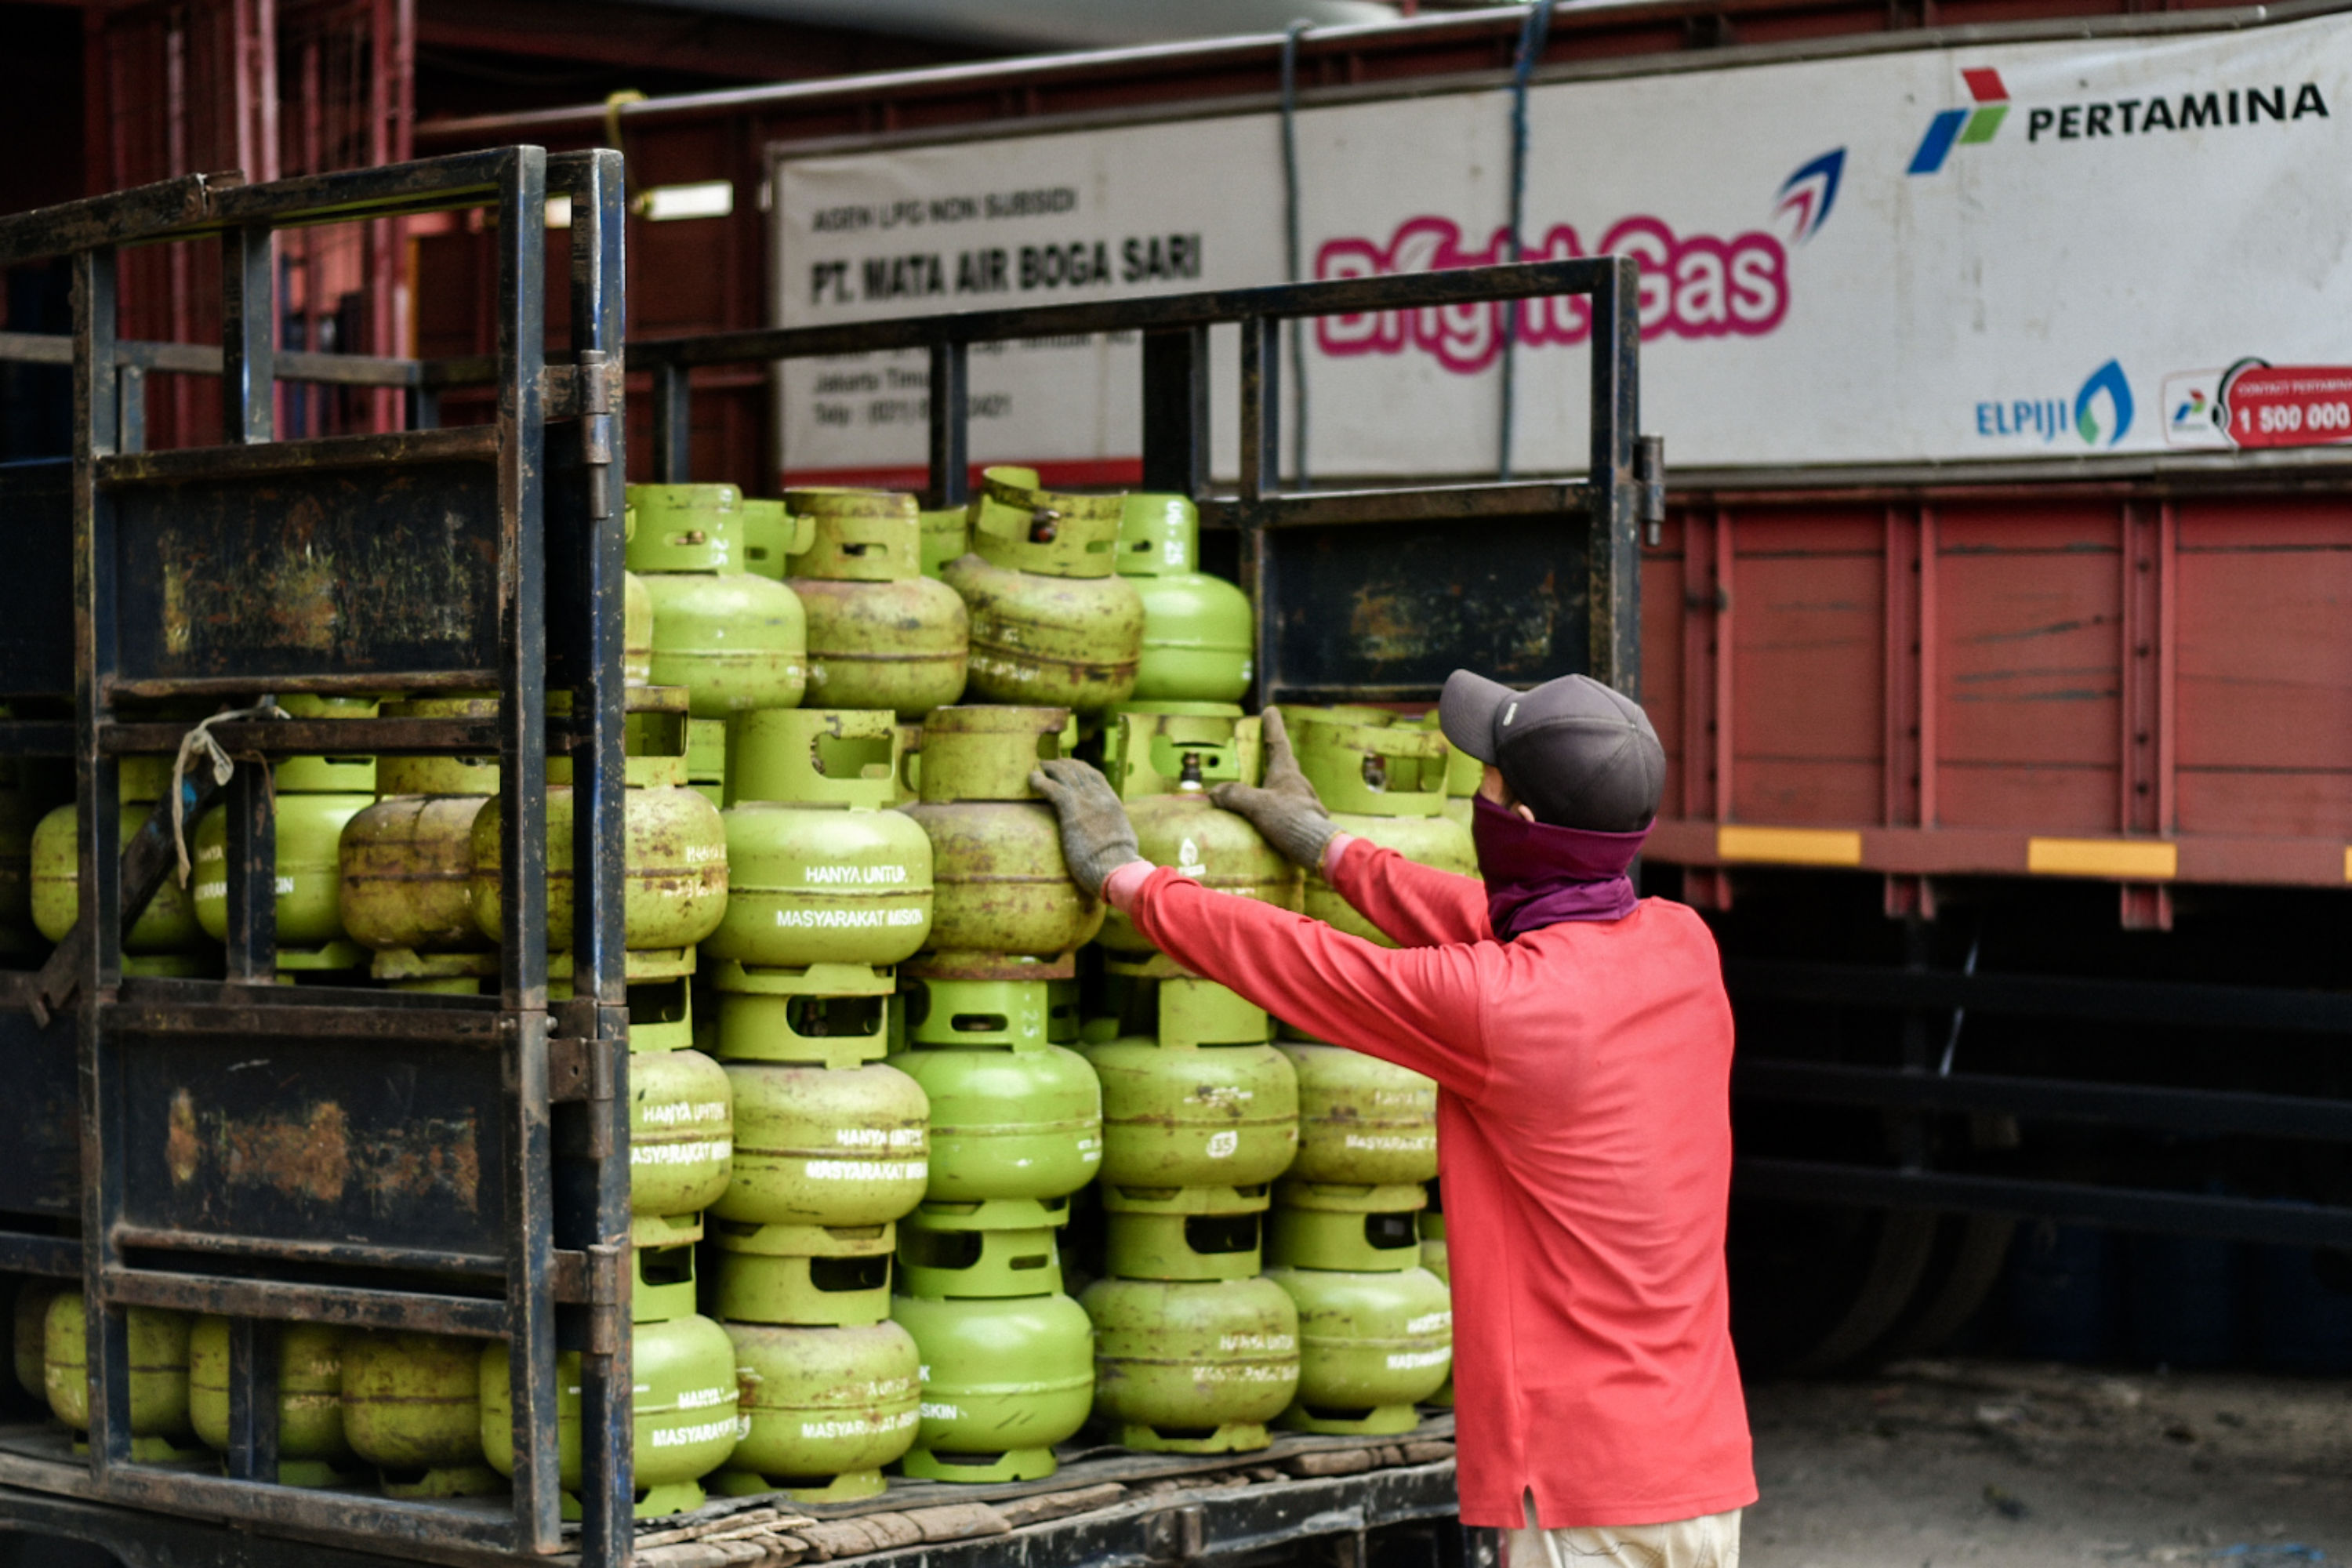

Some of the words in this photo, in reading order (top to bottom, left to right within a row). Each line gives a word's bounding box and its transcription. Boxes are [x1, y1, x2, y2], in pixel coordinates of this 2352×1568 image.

[2028, 82, 2329, 142] PERTAMINA
[878, 199, 926, 229] LPG
[929, 195, 977, 222] NON
[984, 186, 1077, 220] SUBSIDI
[956, 245, 1009, 293] AIR
[1020, 238, 1112, 290] BOGA
[1121, 233, 1202, 283] SARI
[1599, 215, 1791, 342] Gas
[1976, 398, 2067, 443] ELPIJI
[2238, 405, 2251, 434] 1
[2259, 404, 2303, 434] 500
[2307, 401, 2350, 431] 000
[805, 865, 862, 884] HANYA
[776, 909, 886, 927] MASYARAKAT
[887, 907, 924, 926] MISKIN
[643, 1101, 692, 1125] HANYA
[630, 1142, 710, 1165] ASYARAKAT
[805, 1160, 903, 1181] MASYARAKAT
